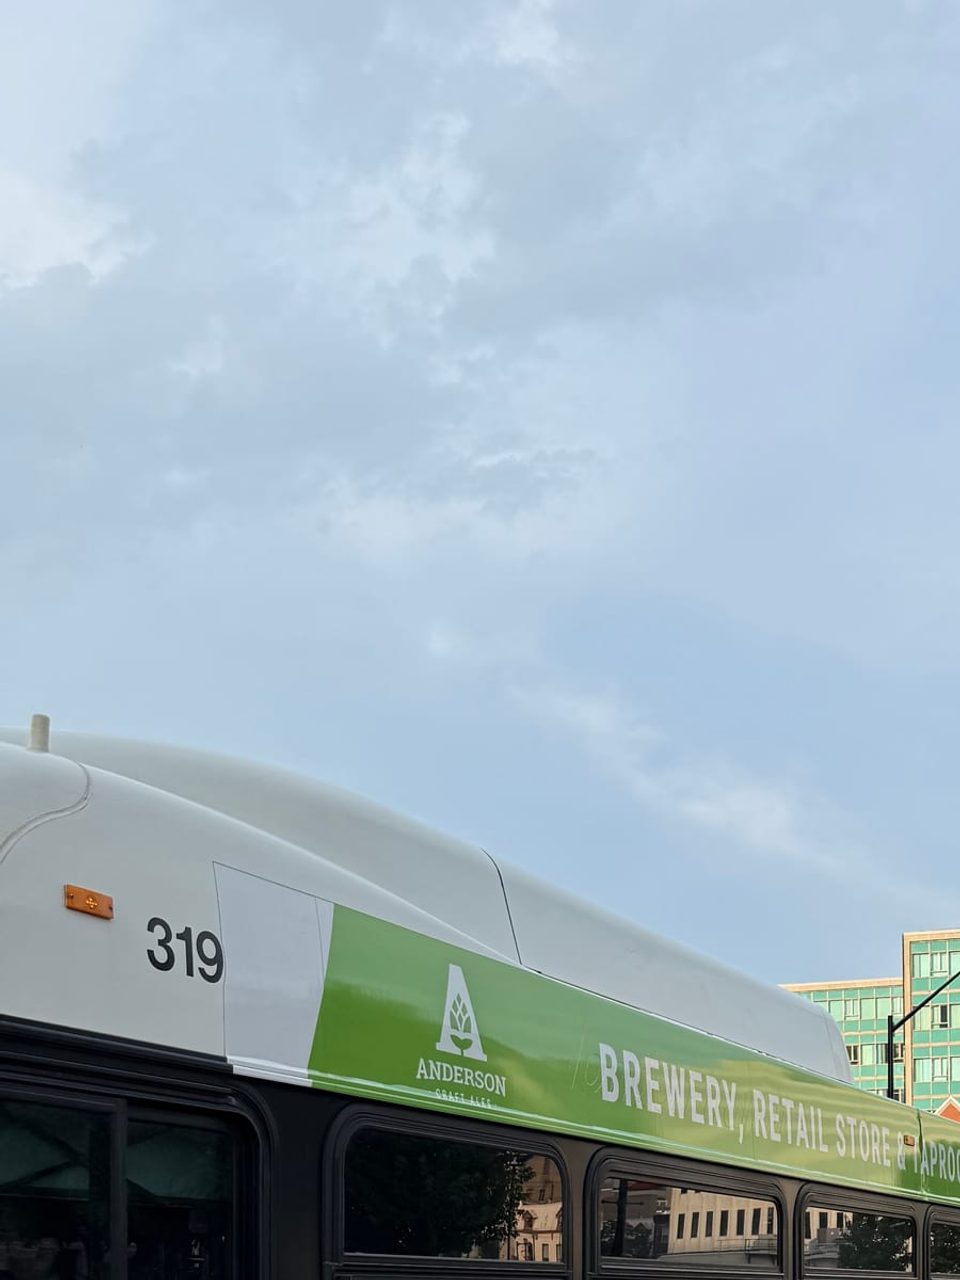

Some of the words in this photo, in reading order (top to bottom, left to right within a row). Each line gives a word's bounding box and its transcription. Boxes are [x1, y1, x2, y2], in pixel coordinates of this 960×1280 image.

[147, 917, 224, 983] 319
[416, 1057, 506, 1096] ANDERSON
[599, 1042, 744, 1144] BREWERY,
[753, 1088, 829, 1153] RETAIL
[836, 1113, 891, 1168] STORE
[897, 1131, 906, 1170] &
